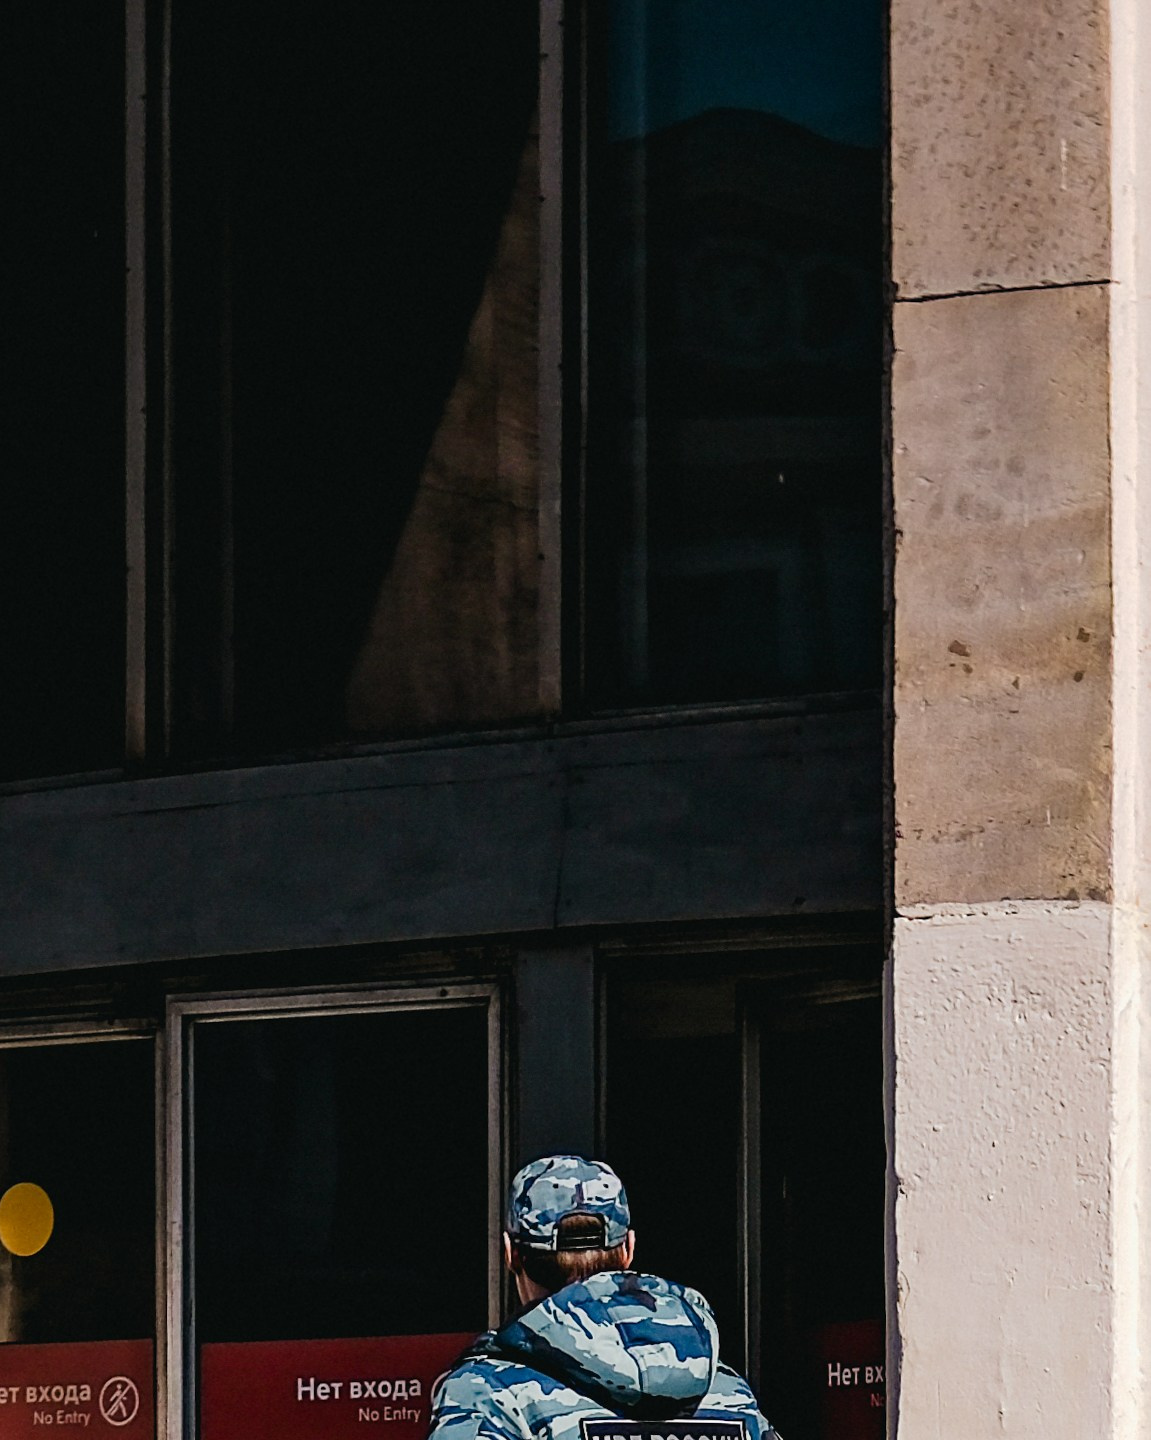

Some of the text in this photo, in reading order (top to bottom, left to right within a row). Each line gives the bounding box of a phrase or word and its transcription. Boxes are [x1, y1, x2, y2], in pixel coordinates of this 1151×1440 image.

[827, 1362, 860, 1388] Нет
[25, 1382, 91, 1407] входа
[296, 1377, 422, 1402] Нет входа
[33, 1410, 91, 1427] No Entry
[358, 1405, 422, 1423] No Entry
